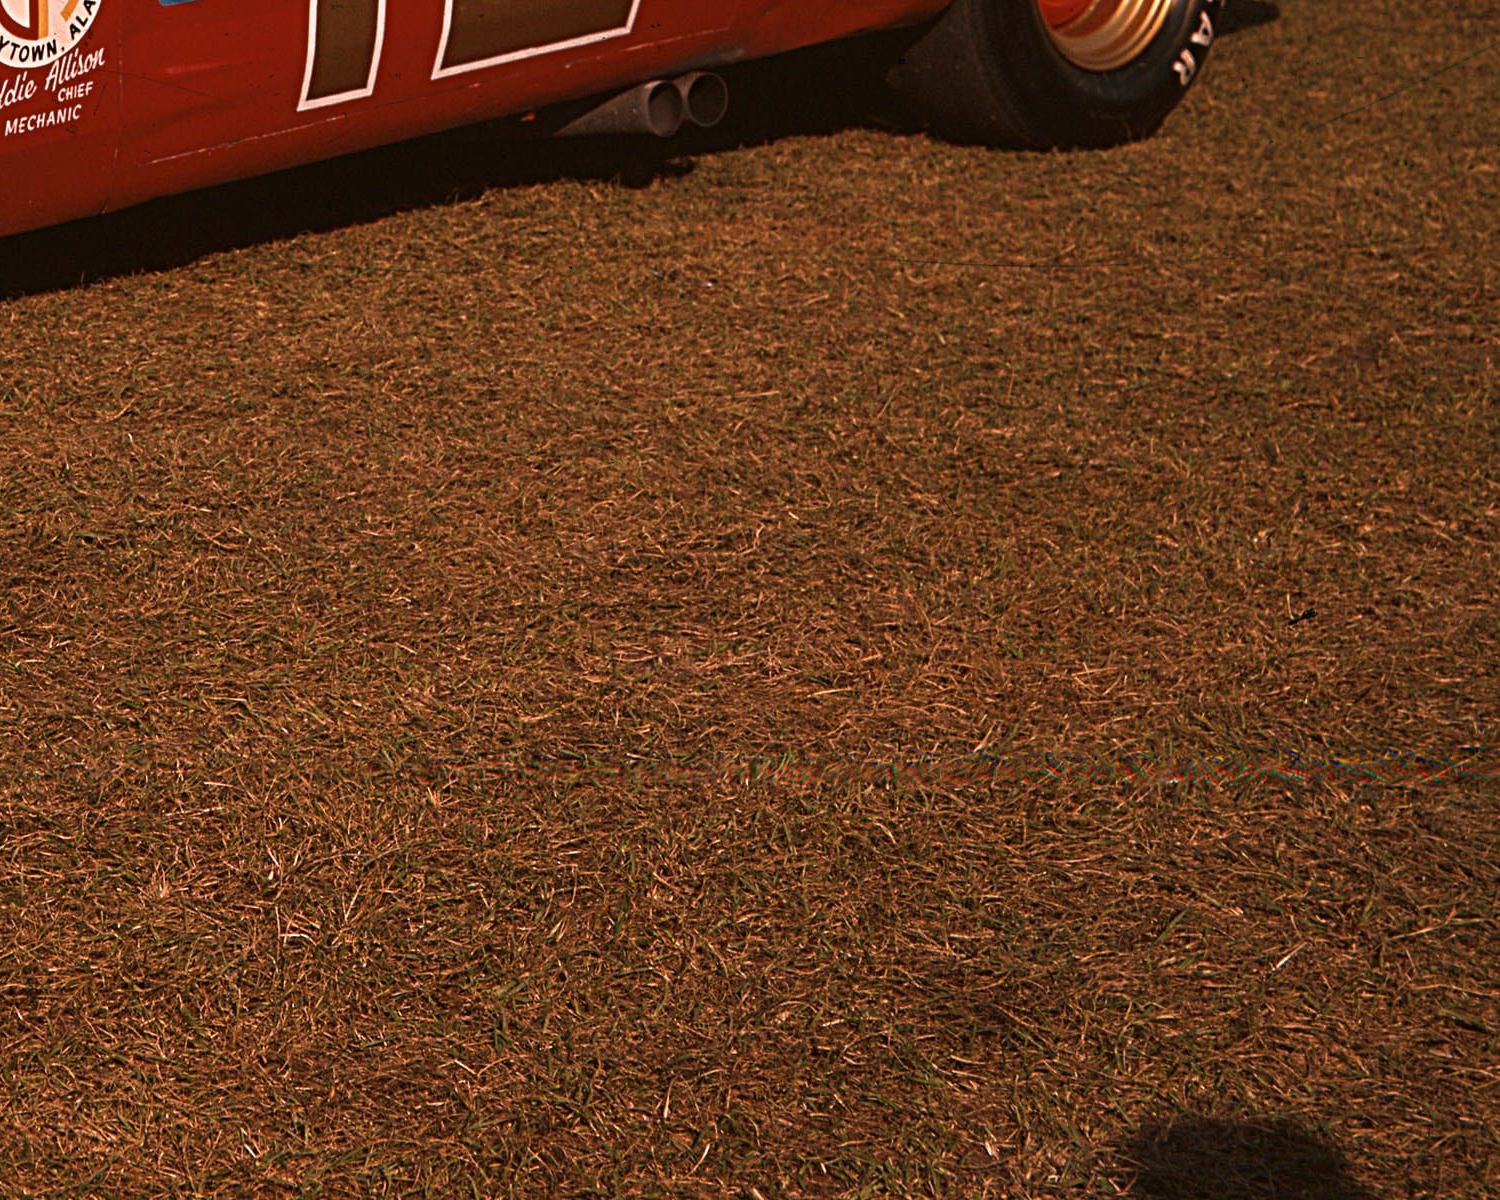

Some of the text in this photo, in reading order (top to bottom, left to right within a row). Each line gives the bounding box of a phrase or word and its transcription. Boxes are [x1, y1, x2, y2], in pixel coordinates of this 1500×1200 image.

[44, 47, 106, 93] Allison
[57, 80, 94, 103] CHIEF
[4, 103, 83, 137] MECHANIC
